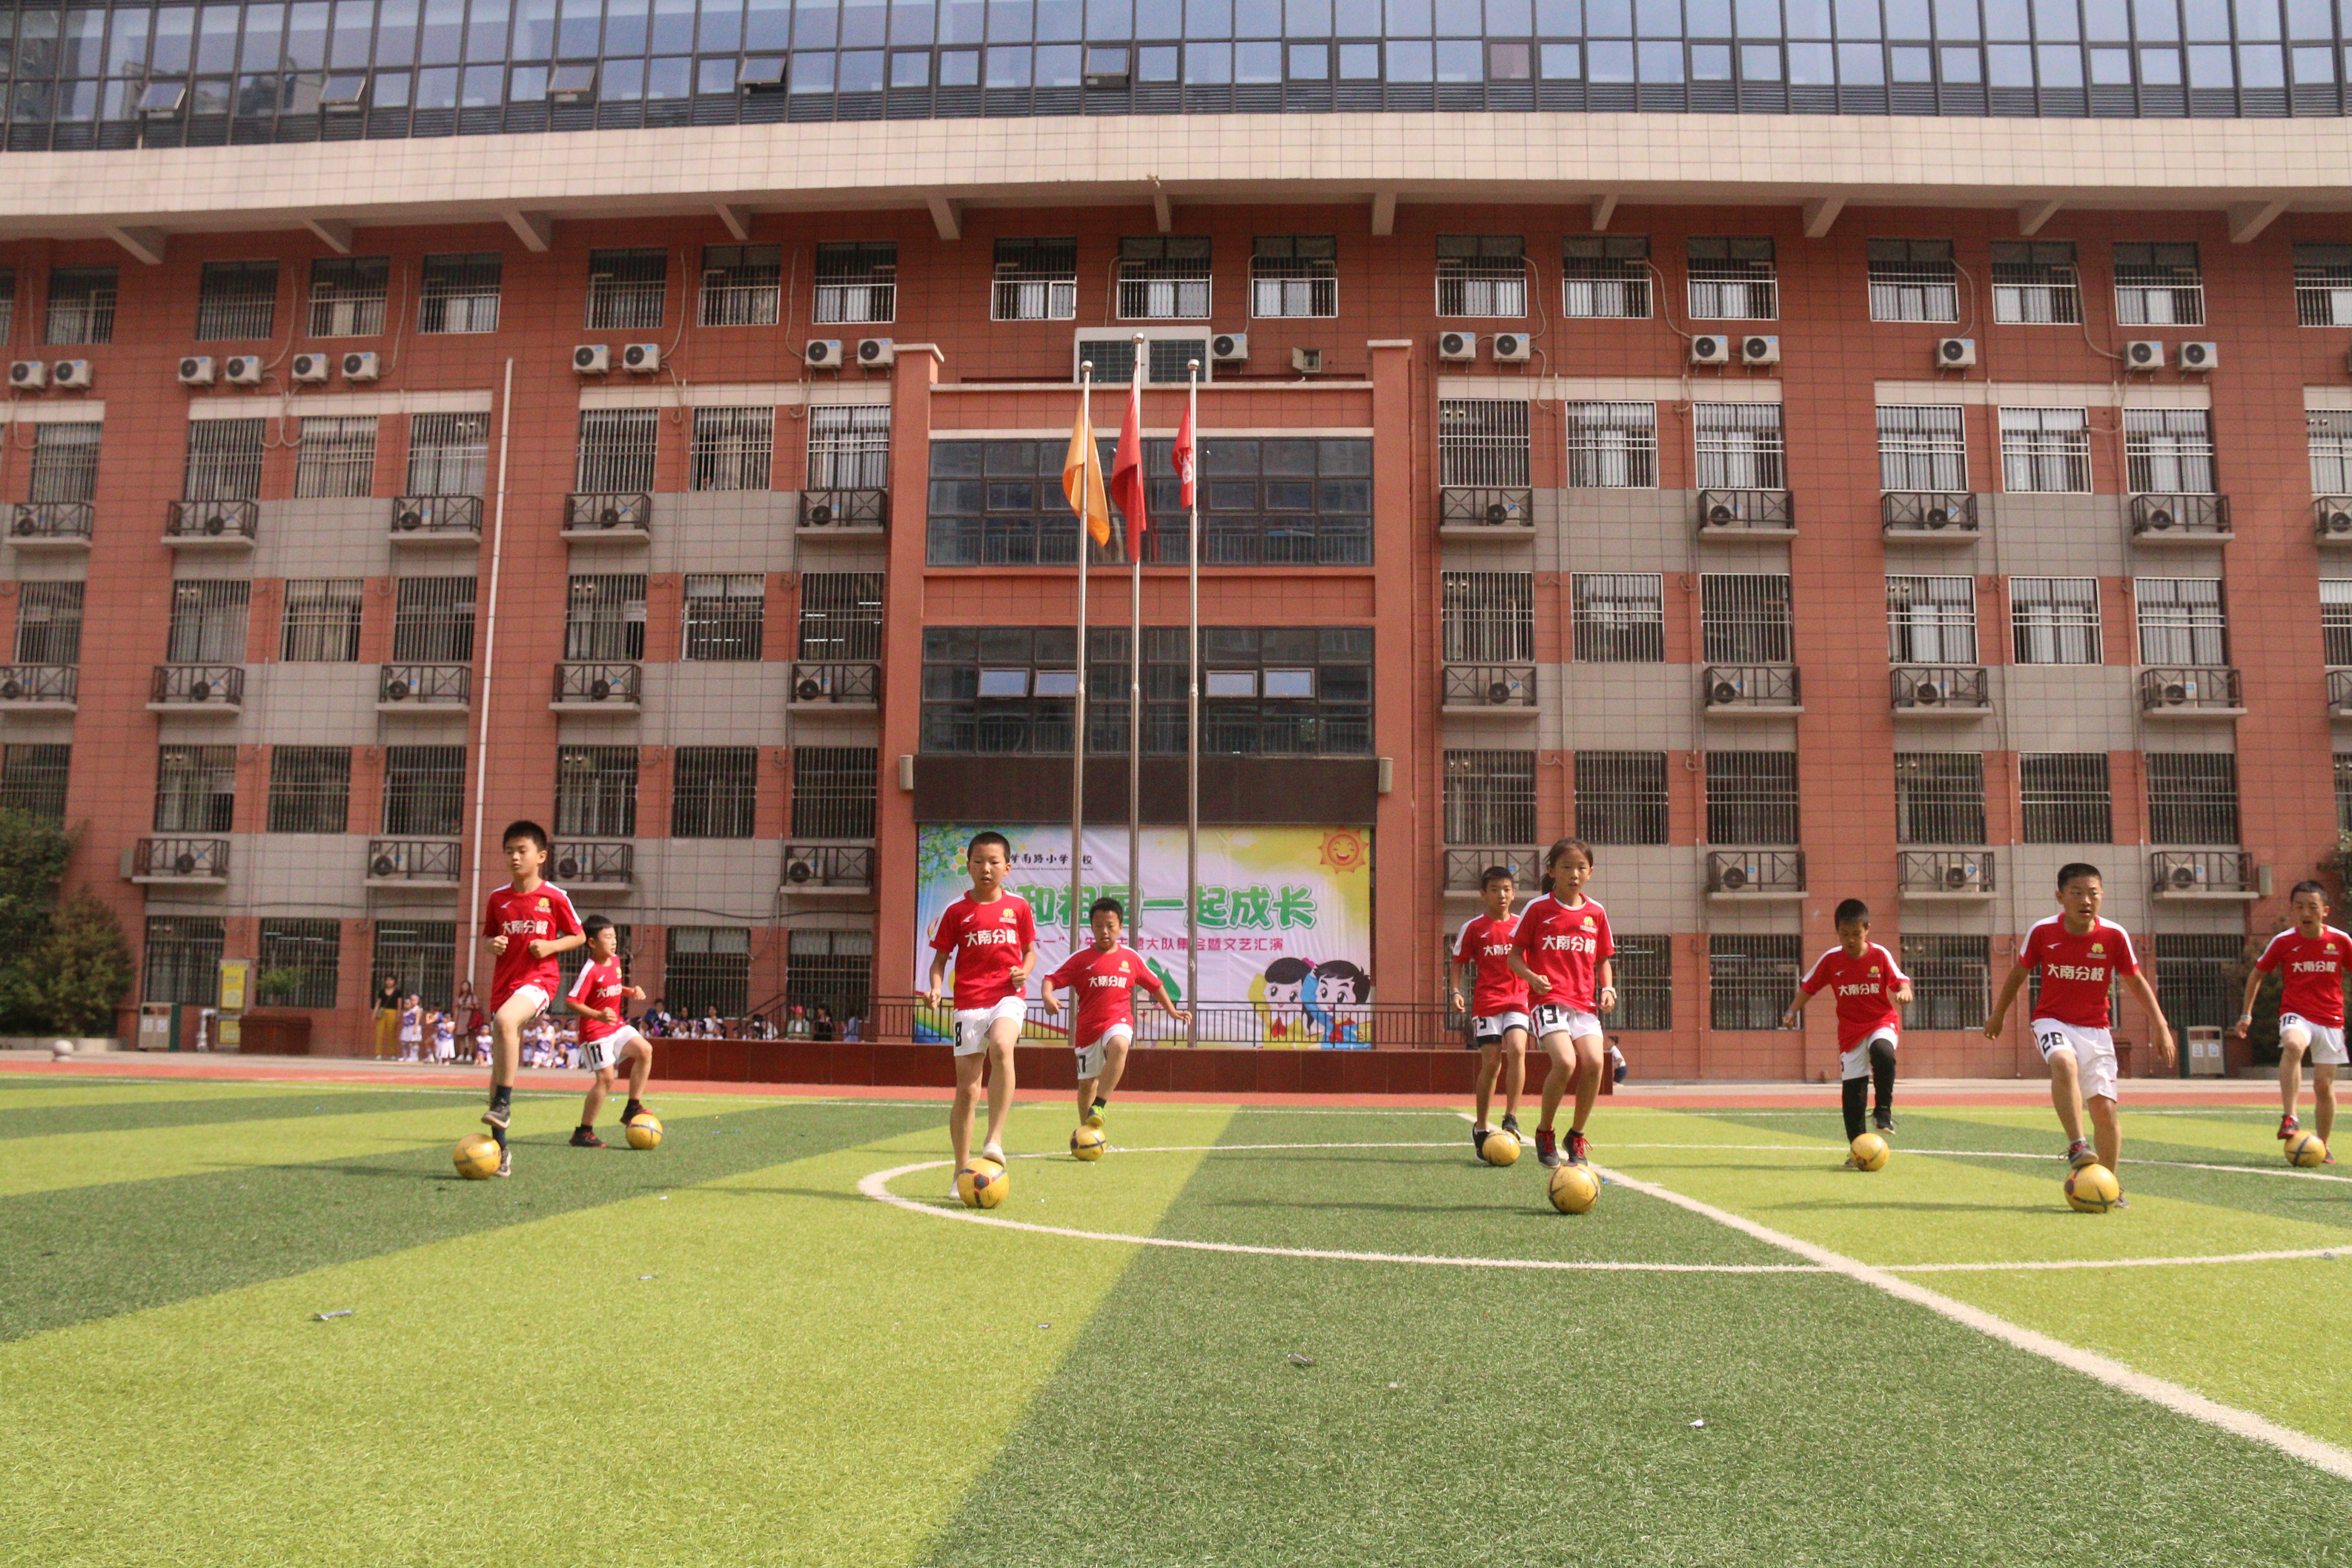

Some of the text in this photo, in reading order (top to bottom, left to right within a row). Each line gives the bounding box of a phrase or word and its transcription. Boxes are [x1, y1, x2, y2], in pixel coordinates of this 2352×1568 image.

[1010, 853, 1092, 865] 学南路小学校
[1000, 882, 1317, 930] 和祖国一起成长
[502, 920, 549, 935] 大南分校
[965, 928, 1017, 947] 大南分校
[1542, 934, 1596, 954] 大南分校
[2048, 963, 2105, 981] 大南分校
[2291, 961, 2337, 972] 大南分校
[1089, 975, 1128, 989] 大南分校
[1838, 982, 1880, 996] 大南分校
[1539, 1004, 1558, 1027] 13
[955, 1022, 962, 1047] 8
[2041, 1032, 2065, 1054] 28
[591, 1044, 603, 1063] 11
